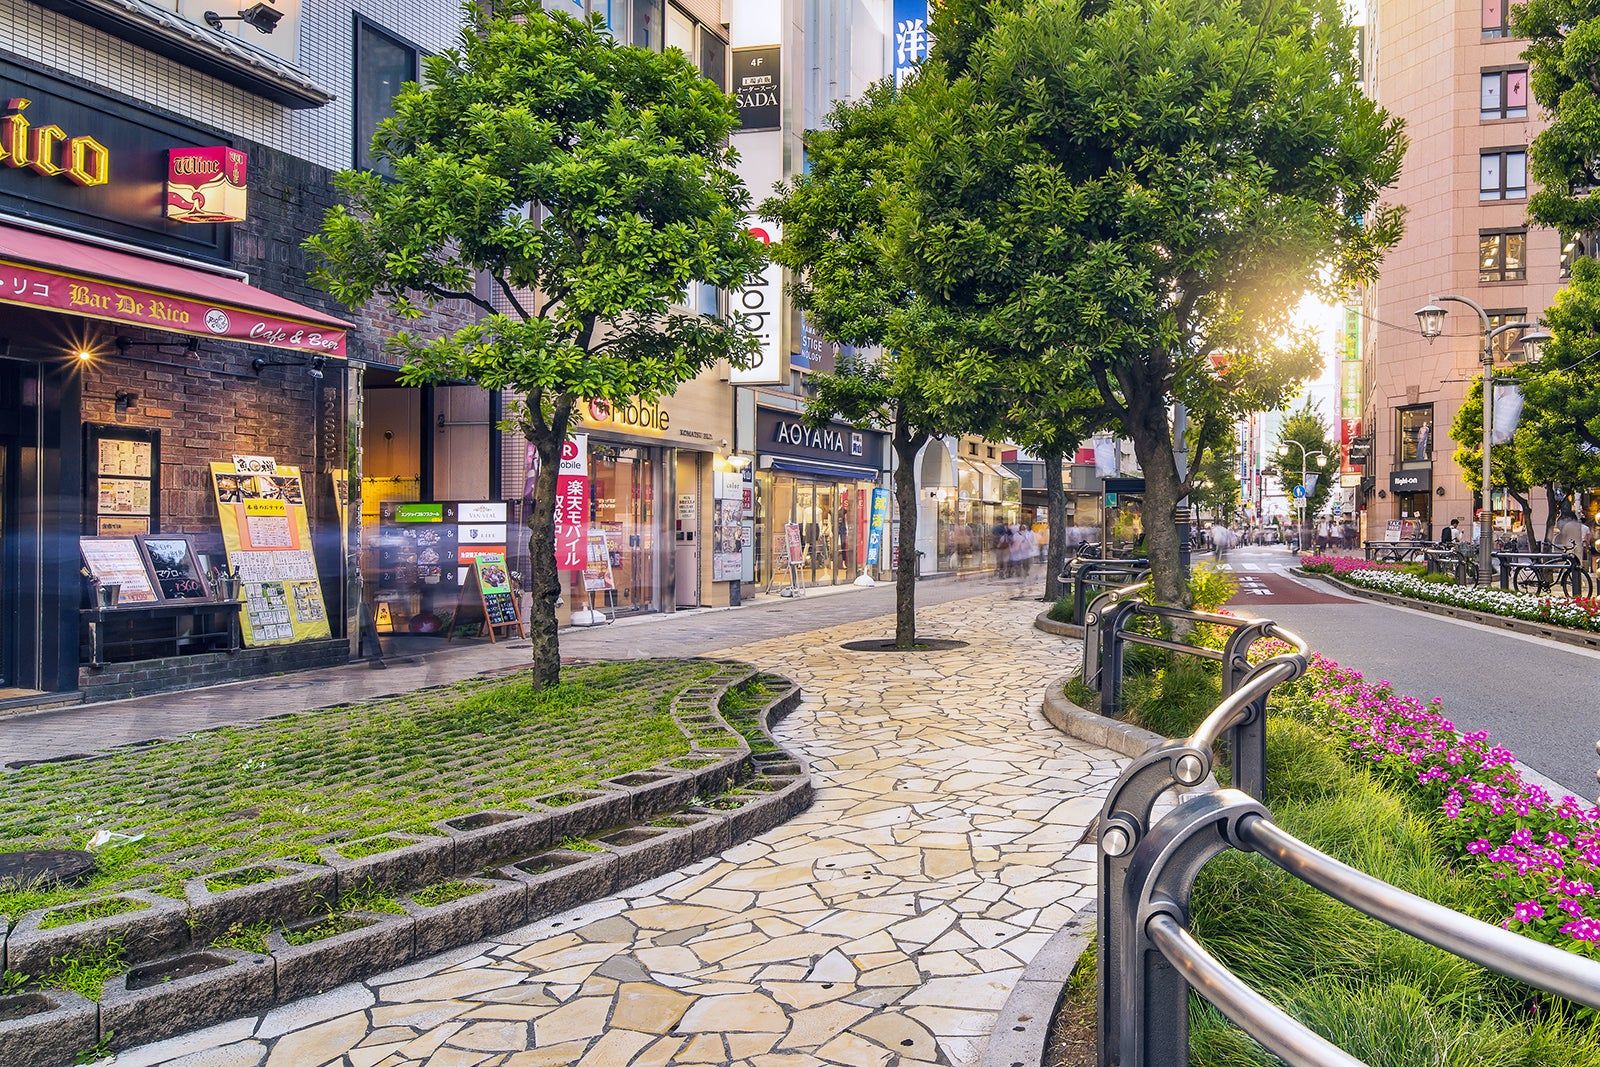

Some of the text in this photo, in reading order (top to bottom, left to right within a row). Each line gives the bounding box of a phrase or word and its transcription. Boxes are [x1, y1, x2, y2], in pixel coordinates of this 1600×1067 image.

[751, 58, 763, 66] 4F
[737, 85, 778, 93] オーダースーツ
[736, 93, 778, 108] SADA
[0, 98, 109, 187] ico
[174, 156, 220, 176] Wine
[69, 284, 111, 309] Bar
[115, 293, 144, 315] De
[149, 300, 190, 323] Rico
[250, 322, 339, 350] Cafe & Beer
[801, 336, 822, 351] STIGE
[778, 421, 844, 452] AOYAMA
[562, 444, 573, 457] R
[560, 460, 581, 469] obile
[565, 480, 583, 566] 楽天モバイル
